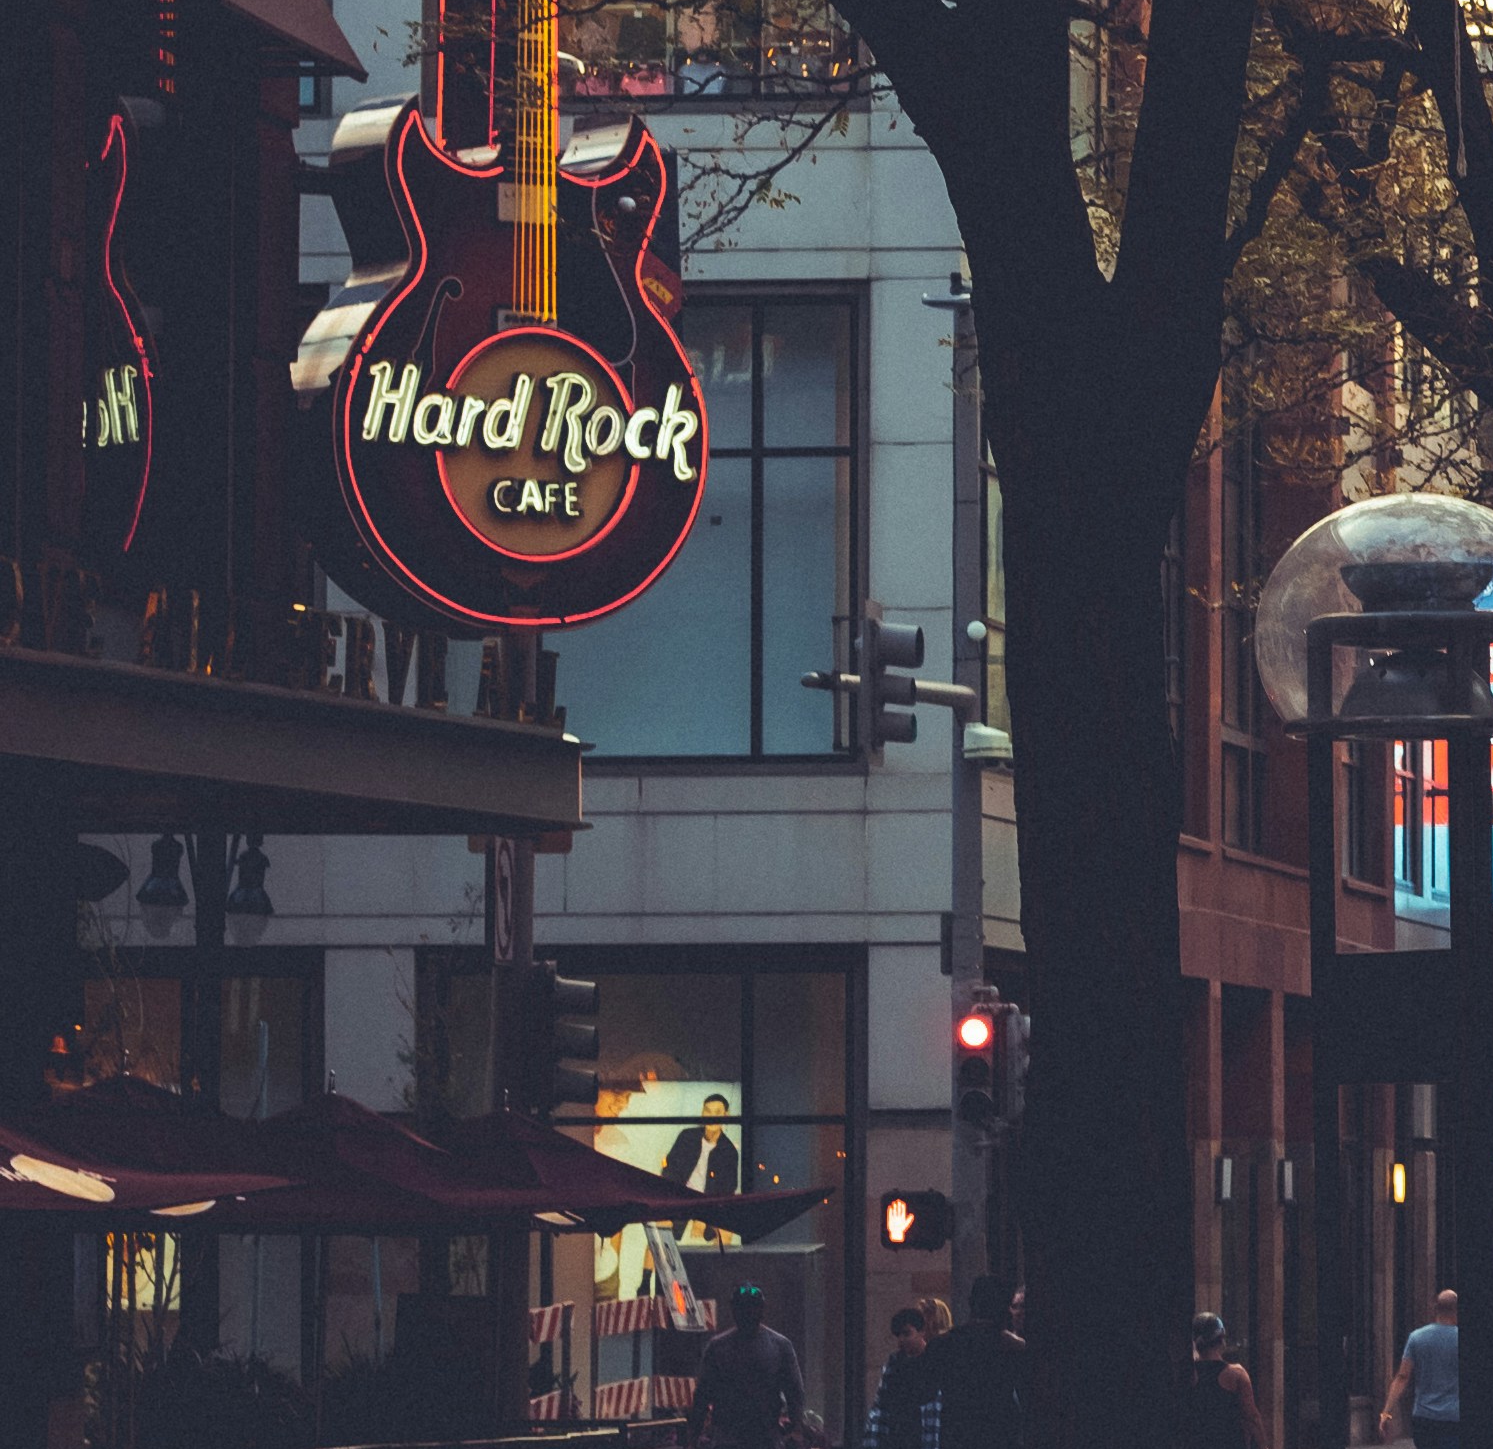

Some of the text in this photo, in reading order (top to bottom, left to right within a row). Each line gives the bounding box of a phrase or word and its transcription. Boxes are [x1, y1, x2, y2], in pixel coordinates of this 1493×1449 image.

[362, 360, 699, 481] Hard Rock
[493, 479, 581, 517] CAFE
